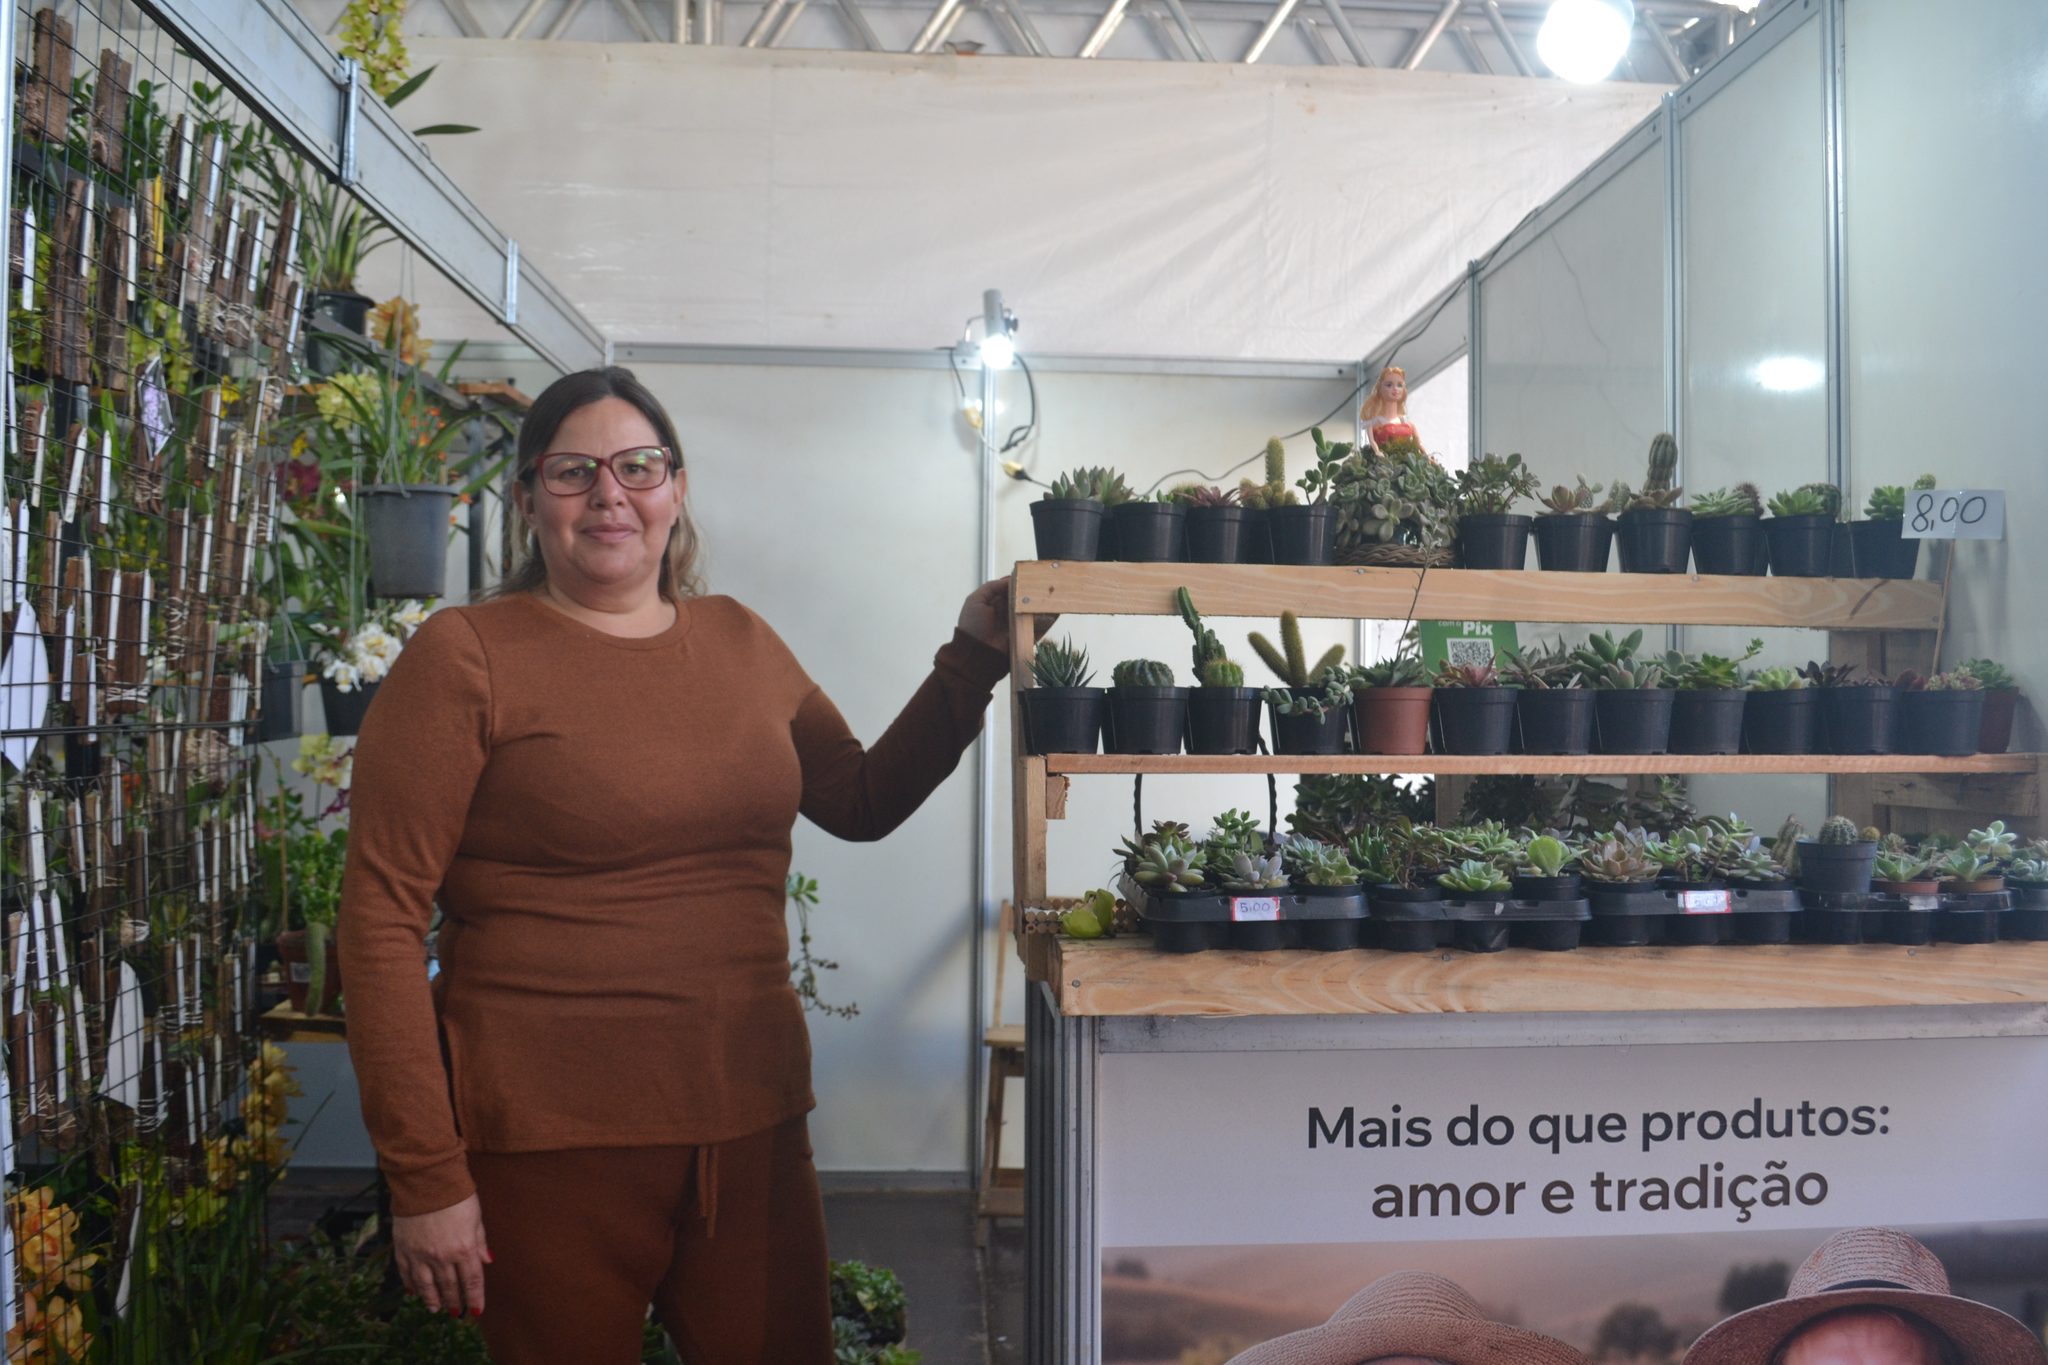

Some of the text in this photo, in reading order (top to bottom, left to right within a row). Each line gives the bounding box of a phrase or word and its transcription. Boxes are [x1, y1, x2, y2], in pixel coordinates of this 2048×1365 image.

[1911, 493, 1987, 533] 8,00
[1463, 620, 1494, 636] Pix
[1308, 1097, 1890, 1154] Mais do que produtos:
[1371, 1160, 1829, 1223] amor e tradição
